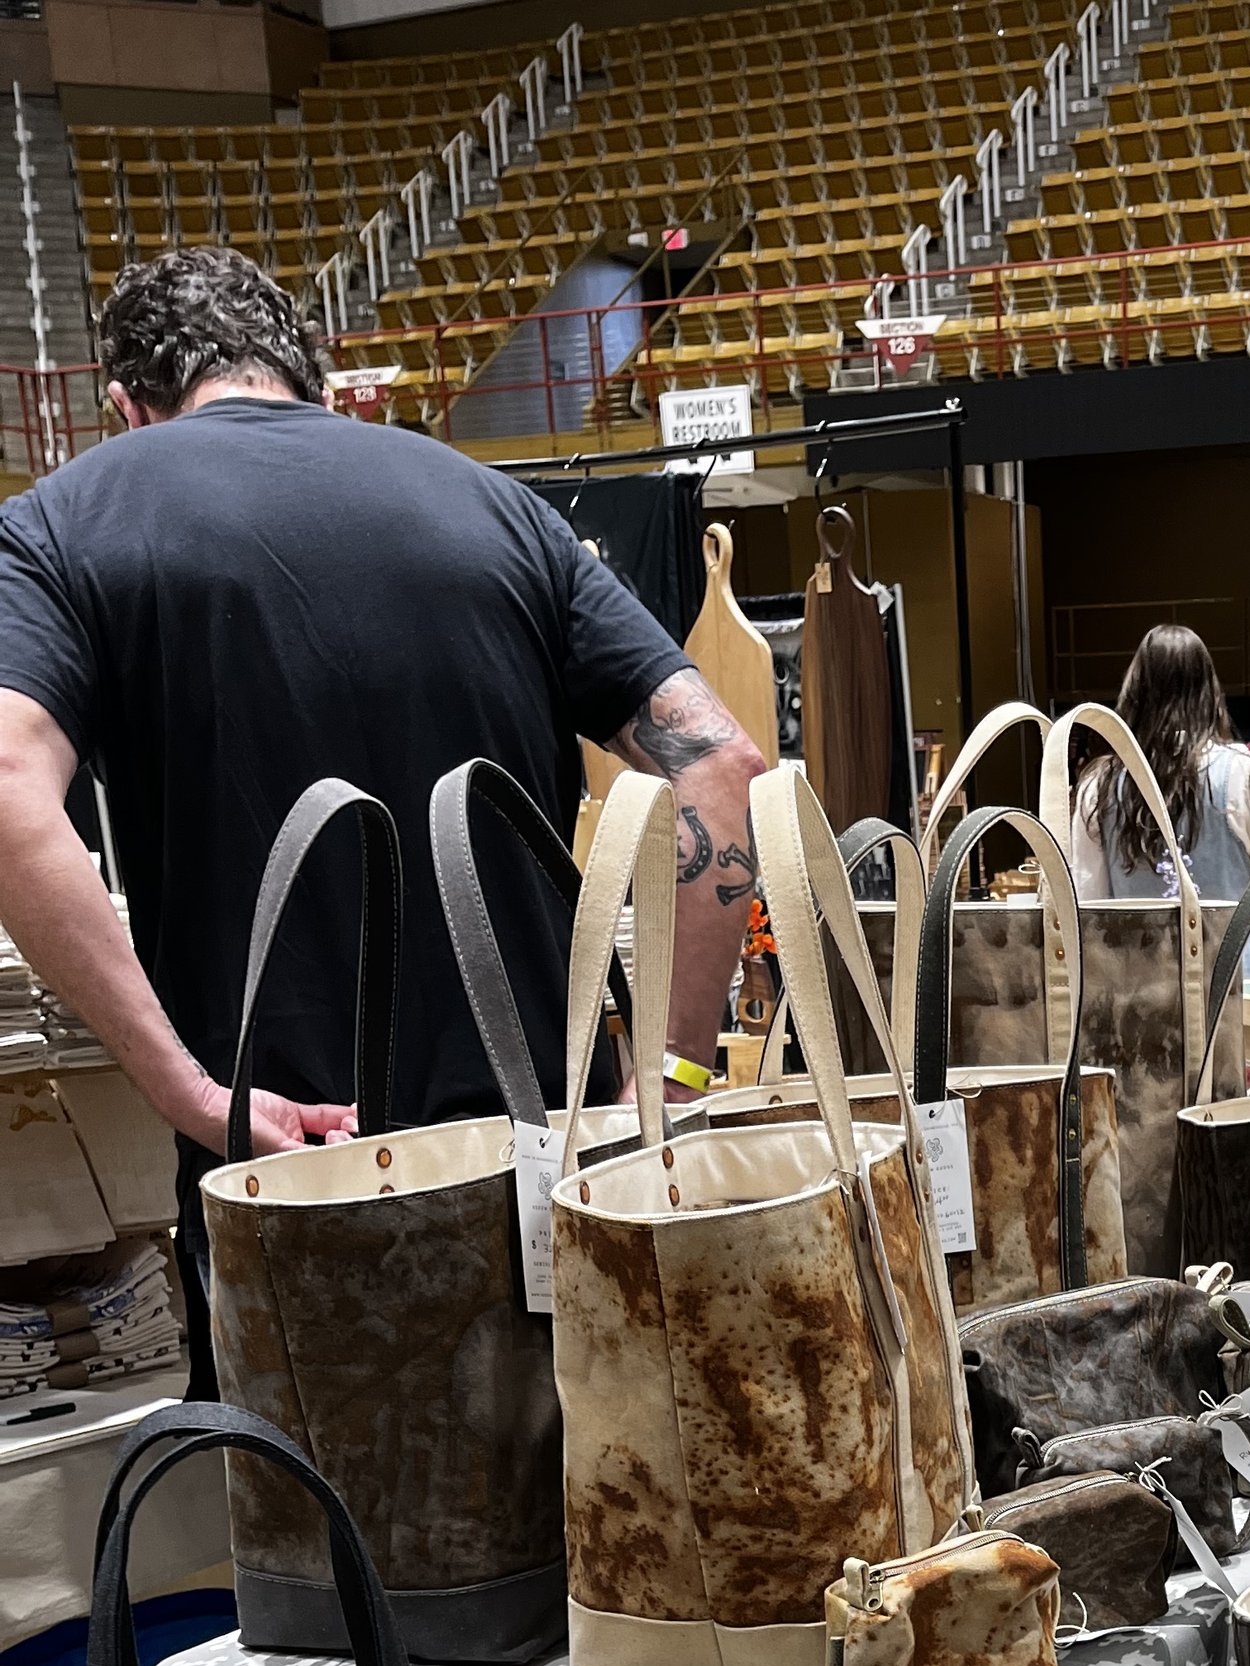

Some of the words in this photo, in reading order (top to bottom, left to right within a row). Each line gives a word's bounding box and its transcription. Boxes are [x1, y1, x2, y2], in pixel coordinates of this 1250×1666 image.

[888, 336, 916, 355] 126
[673, 397, 736, 419] WOMEN'S
[672, 422, 741, 443] RESTROOM
